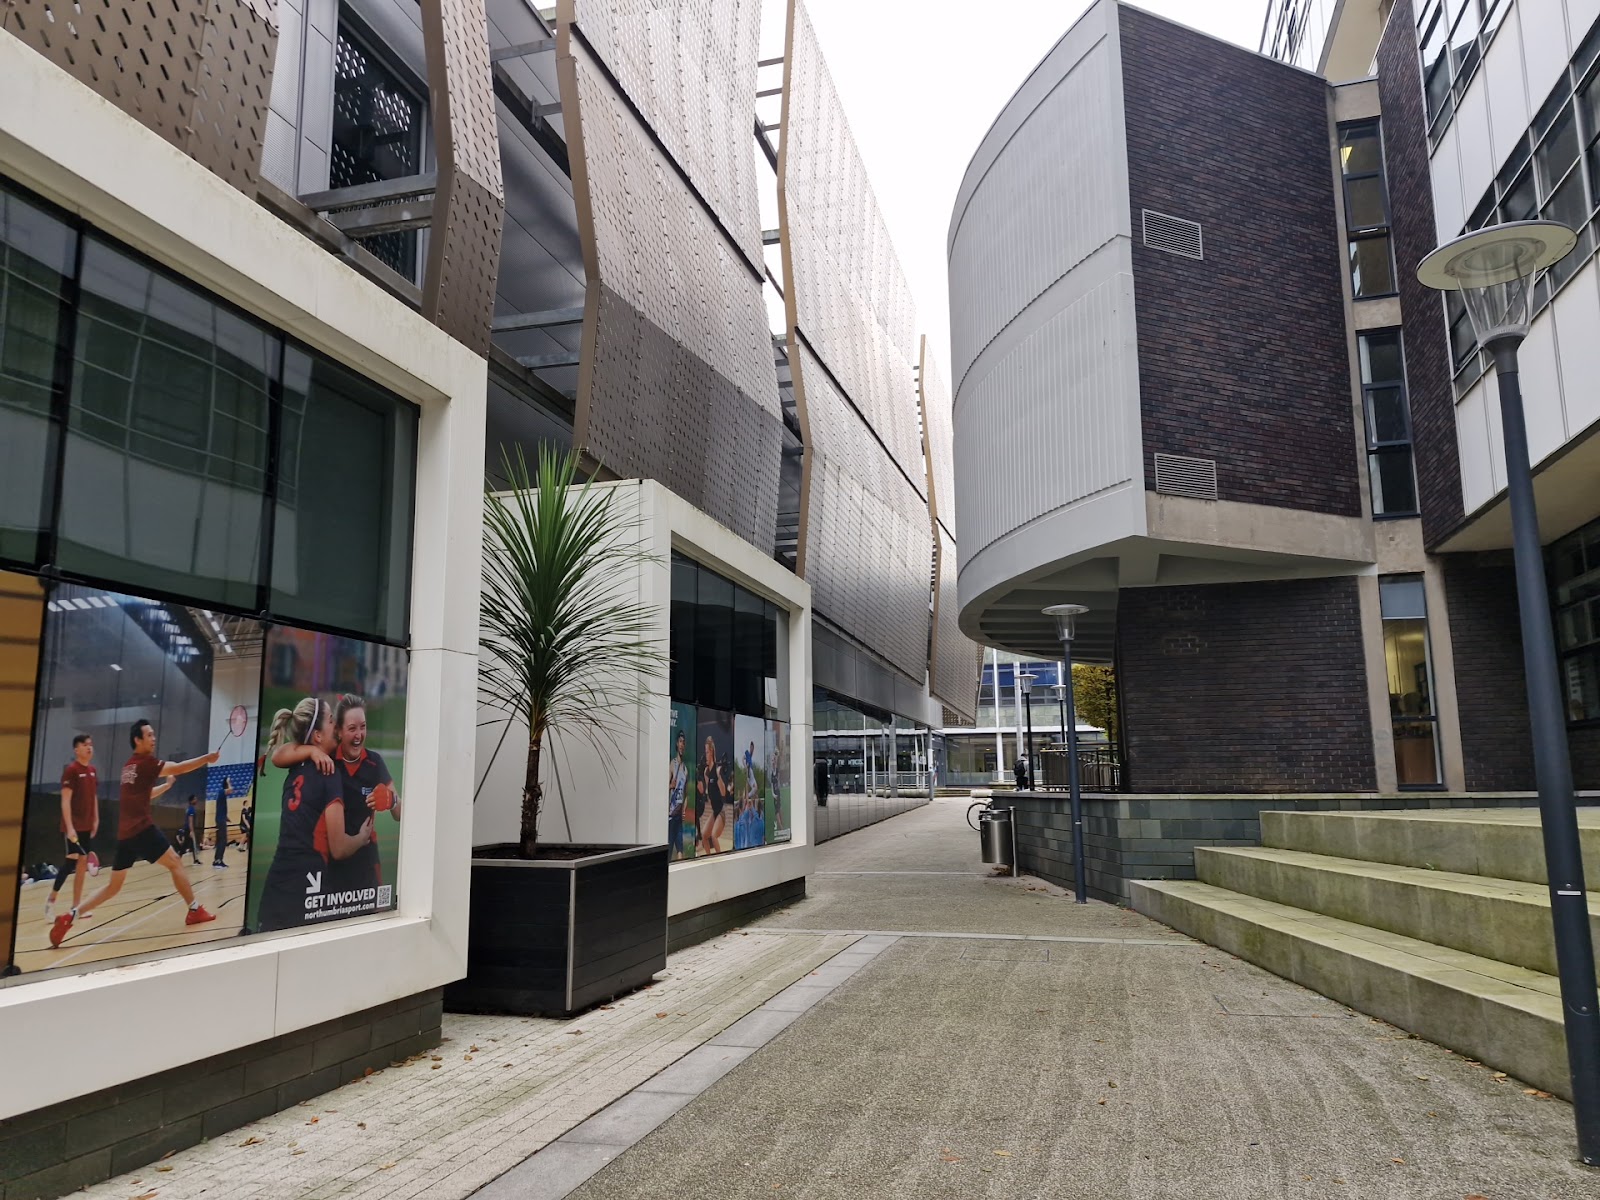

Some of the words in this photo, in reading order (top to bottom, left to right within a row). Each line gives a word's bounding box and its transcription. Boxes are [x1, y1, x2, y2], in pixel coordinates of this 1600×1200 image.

[288, 774, 304, 811] 3
[304, 894, 326, 910] GET
[327, 888, 376, 905] INVOLVED
[304, 903, 375, 919] northumbriasport.com
